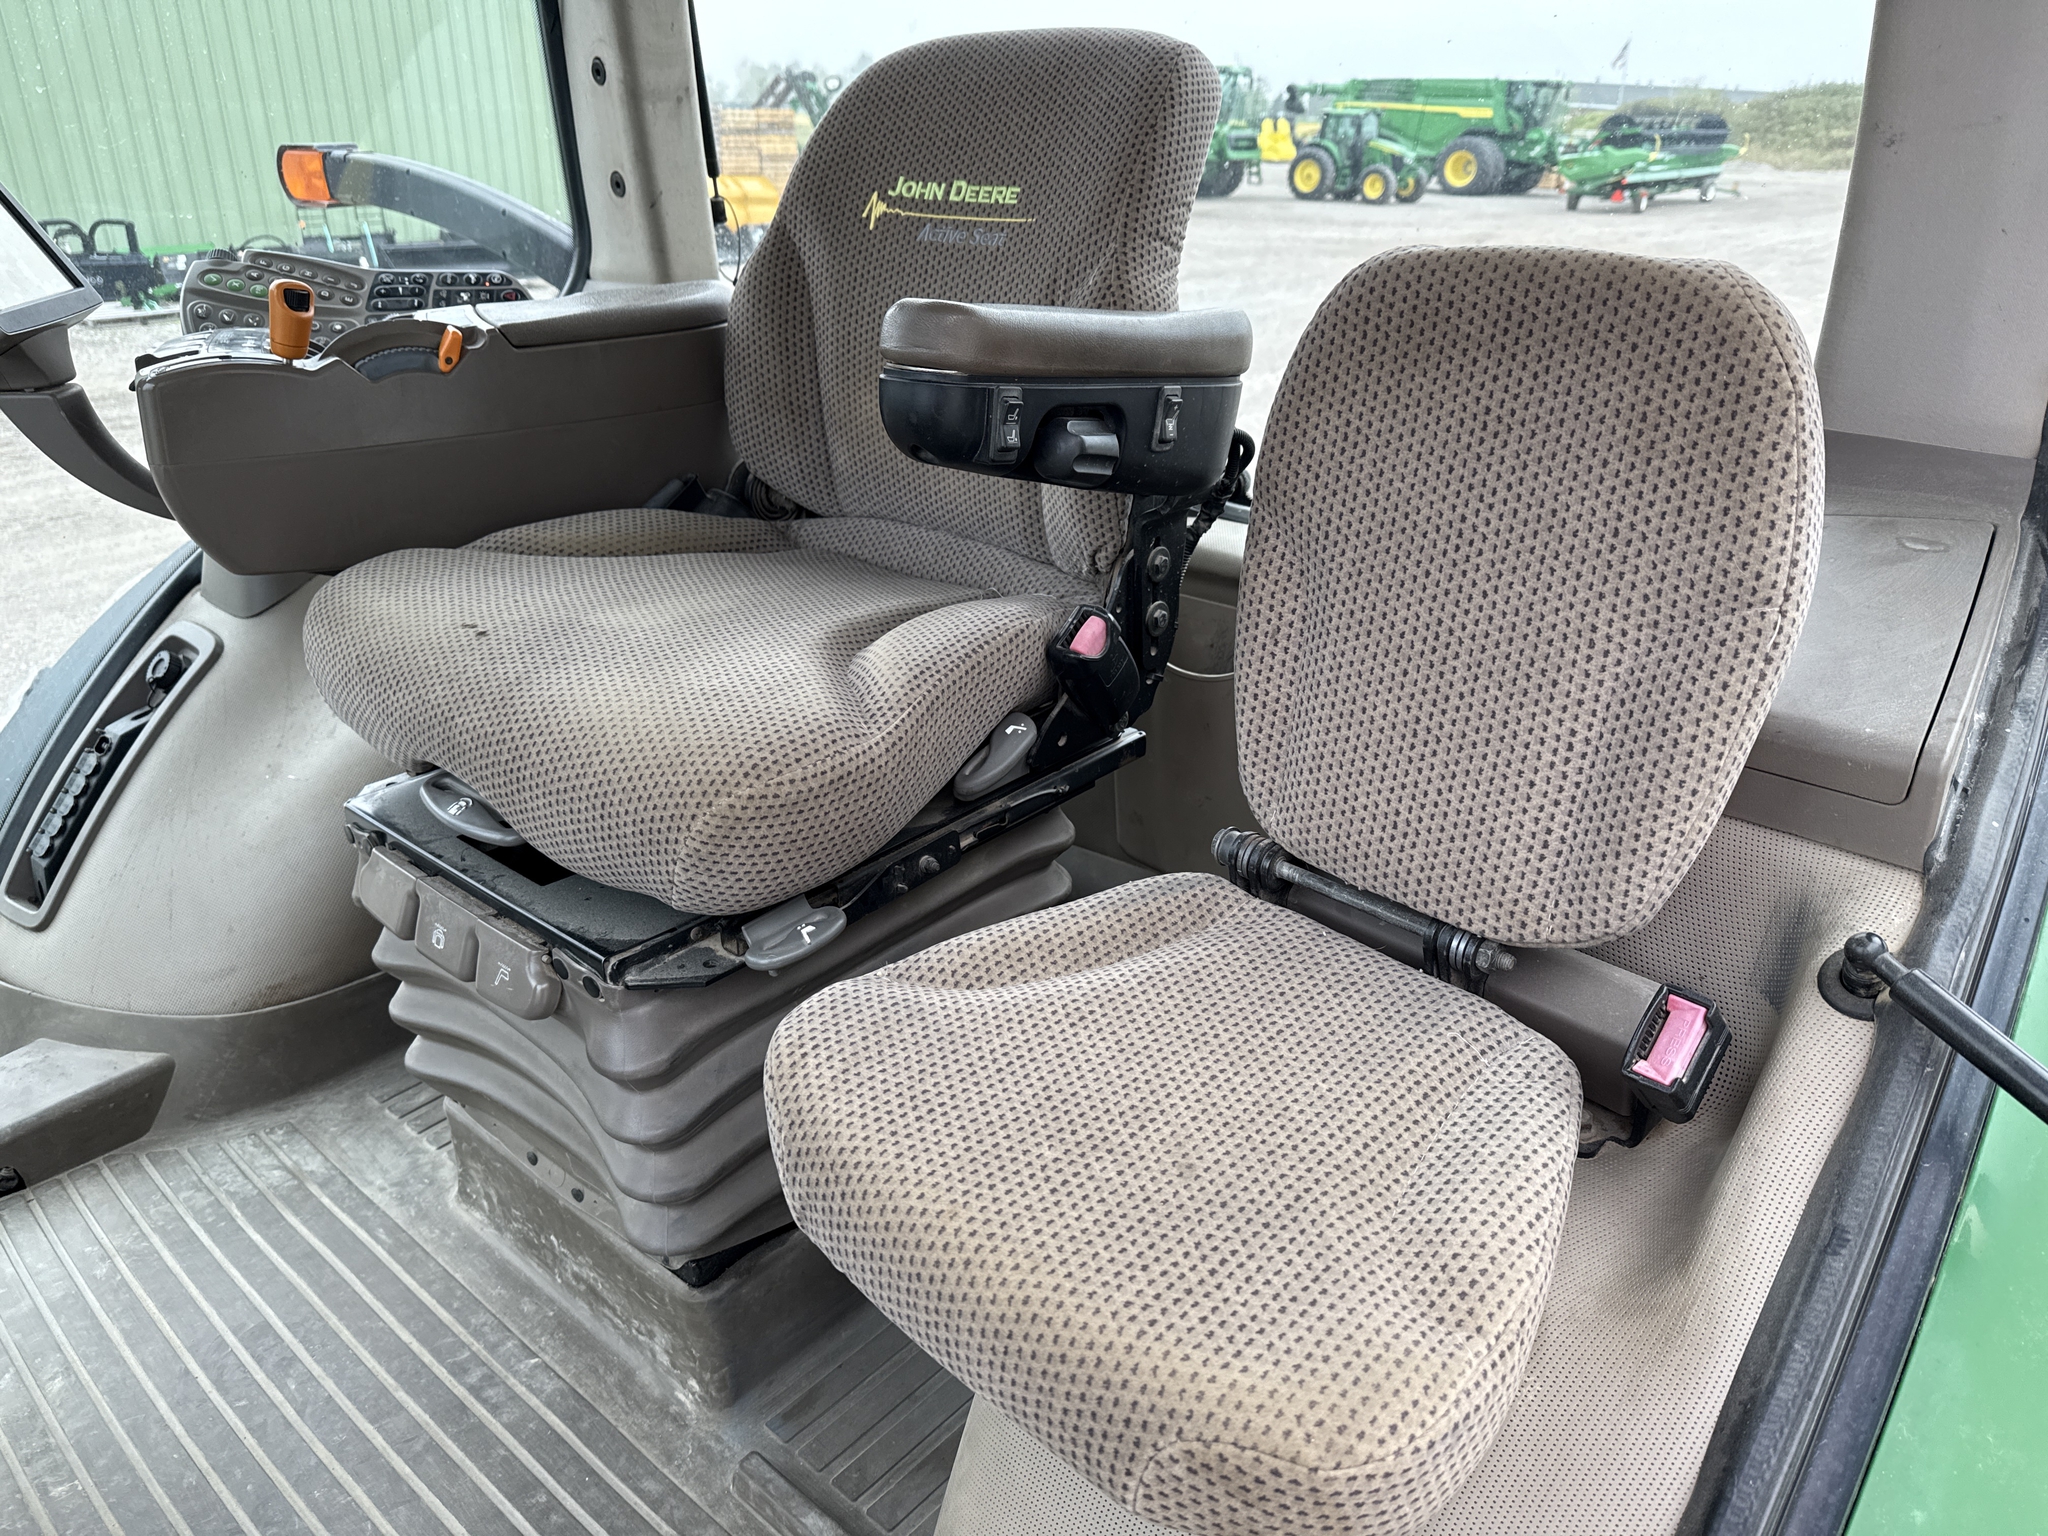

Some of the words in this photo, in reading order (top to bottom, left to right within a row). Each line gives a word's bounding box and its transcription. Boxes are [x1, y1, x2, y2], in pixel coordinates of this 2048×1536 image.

[888, 176, 946, 201] JOHN
[949, 179, 1021, 204] DEERE
[916, 223, 967, 244] Active
[969, 227, 1008, 247] Seat
[1660, 1020, 1692, 1067] PRESS
